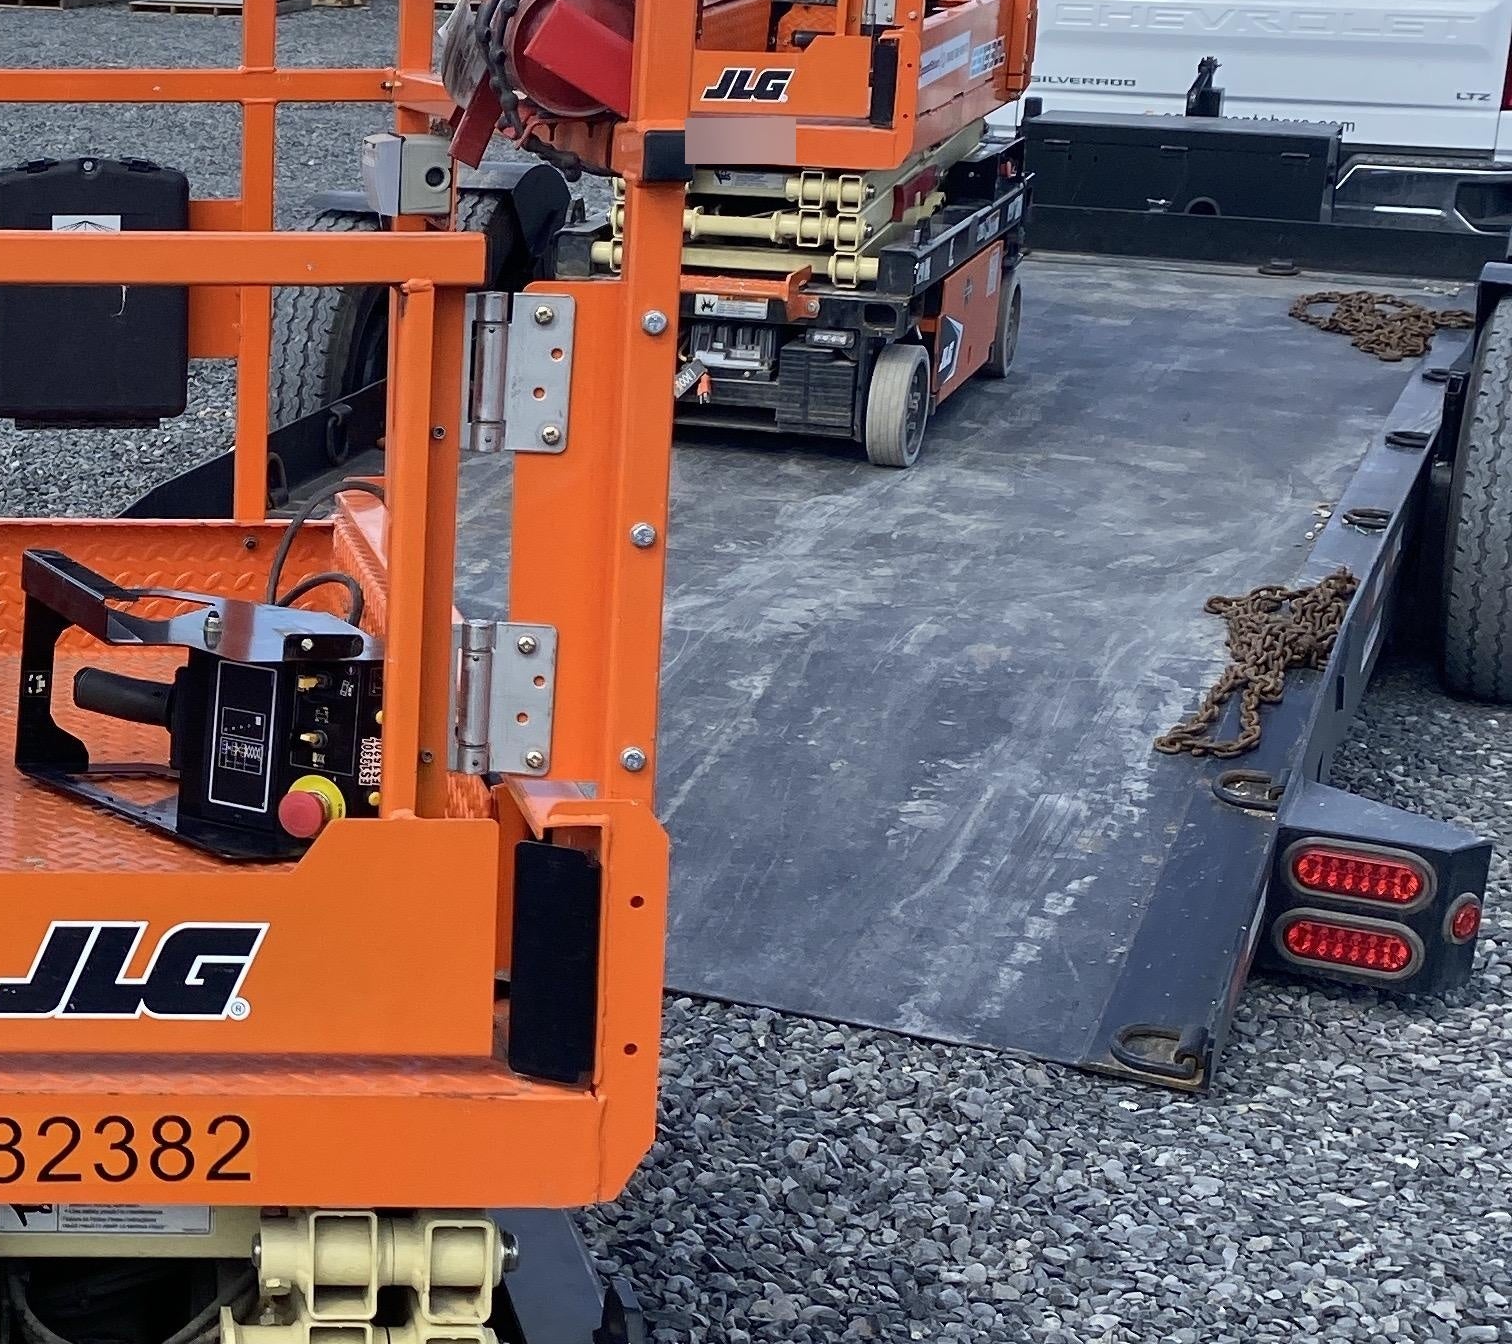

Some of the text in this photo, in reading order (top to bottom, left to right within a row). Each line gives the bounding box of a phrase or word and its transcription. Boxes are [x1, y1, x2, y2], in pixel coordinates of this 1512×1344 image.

[1055, 2, 1479, 39] CHEVROLET
[700, 67, 795, 103] JLG
[1031, 75, 1136, 87] SILVERADO
[1456, 92, 1491, 101] LTZ
[360, 737, 375, 785] ES1330L
